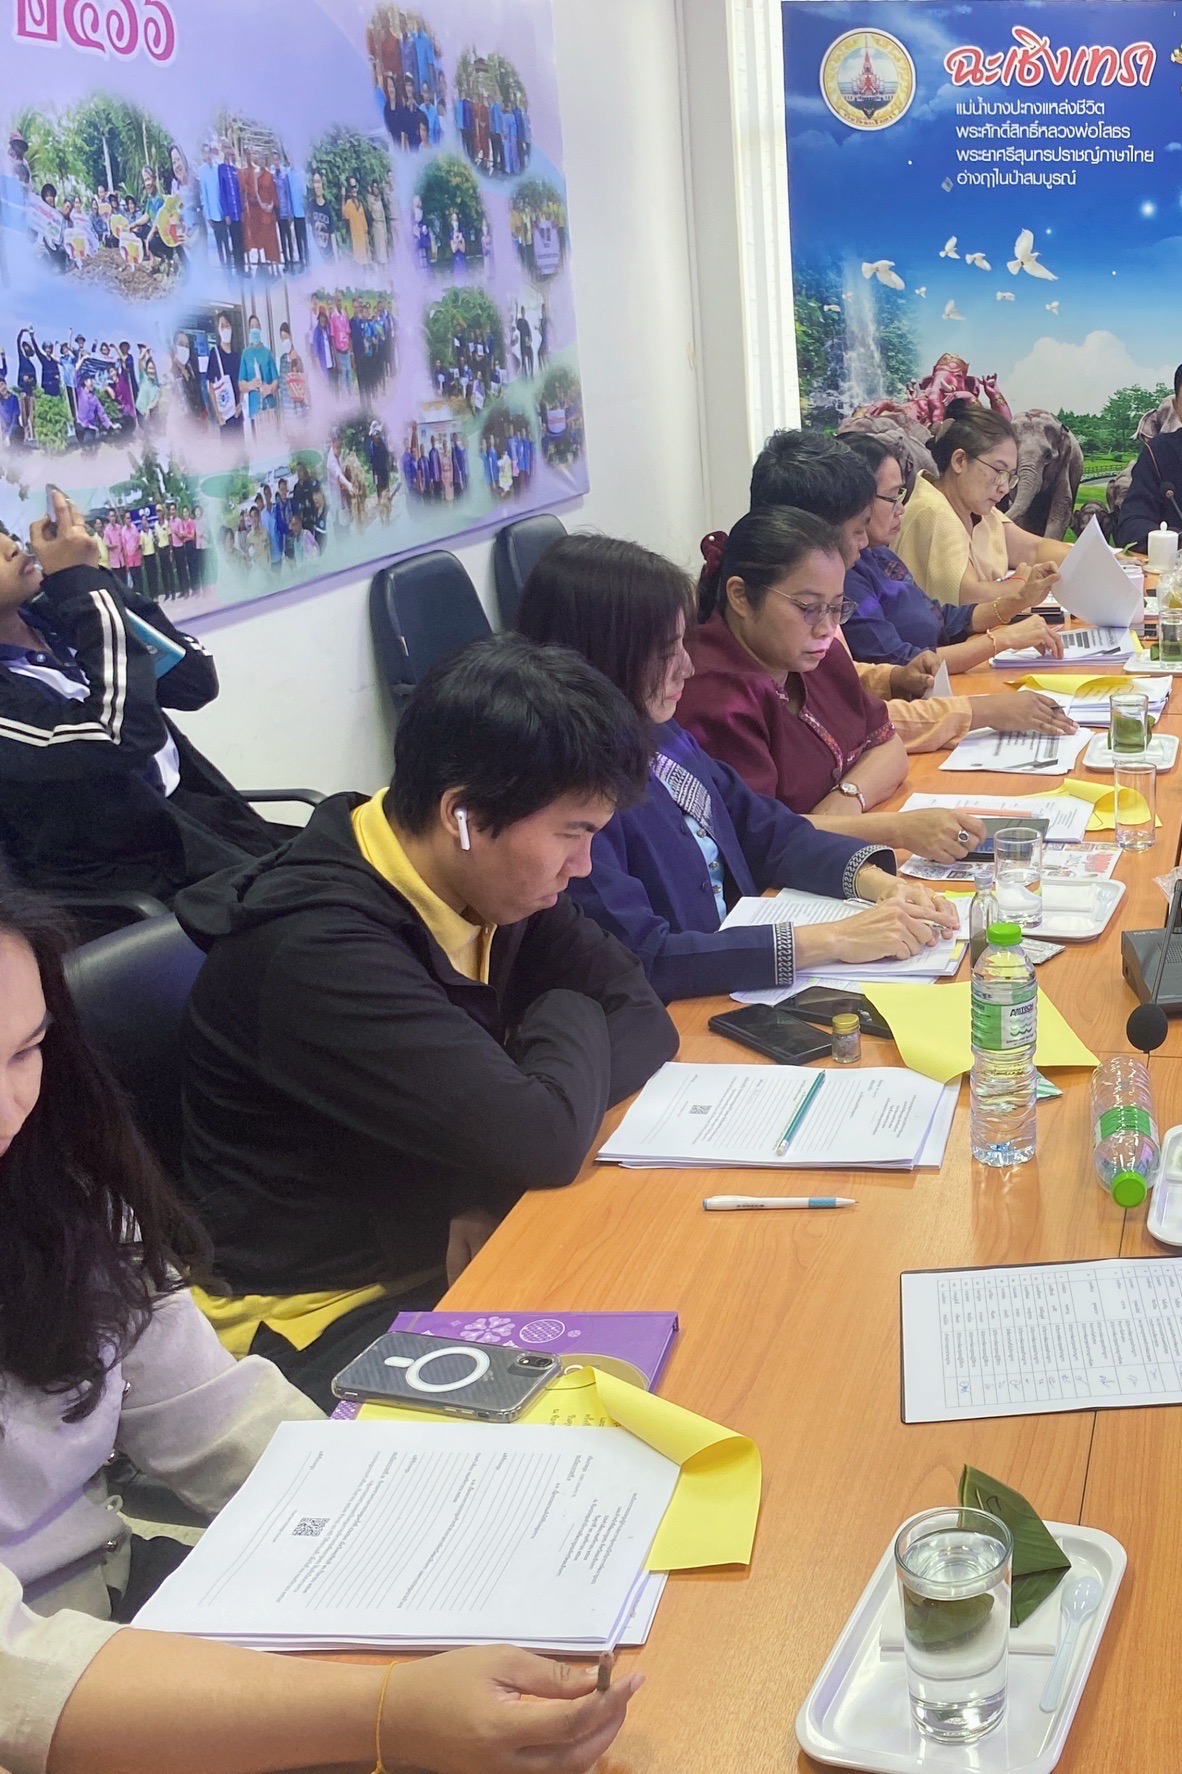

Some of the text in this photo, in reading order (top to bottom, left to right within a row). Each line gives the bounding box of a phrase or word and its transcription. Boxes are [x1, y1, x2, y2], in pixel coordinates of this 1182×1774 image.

[944, 25, 1156, 87] ฉะเชิงเทรา
[956, 96, 1105, 115] แม่น้ำบางปะกงแหล่งชีวิต
[955, 120, 1131, 139] พระศักดิ์สิทธิ์หลวงพ่อโสธร
[955, 145, 1154, 166] พระยาศรีสุนทรปราชญ์ภาษาไทย
